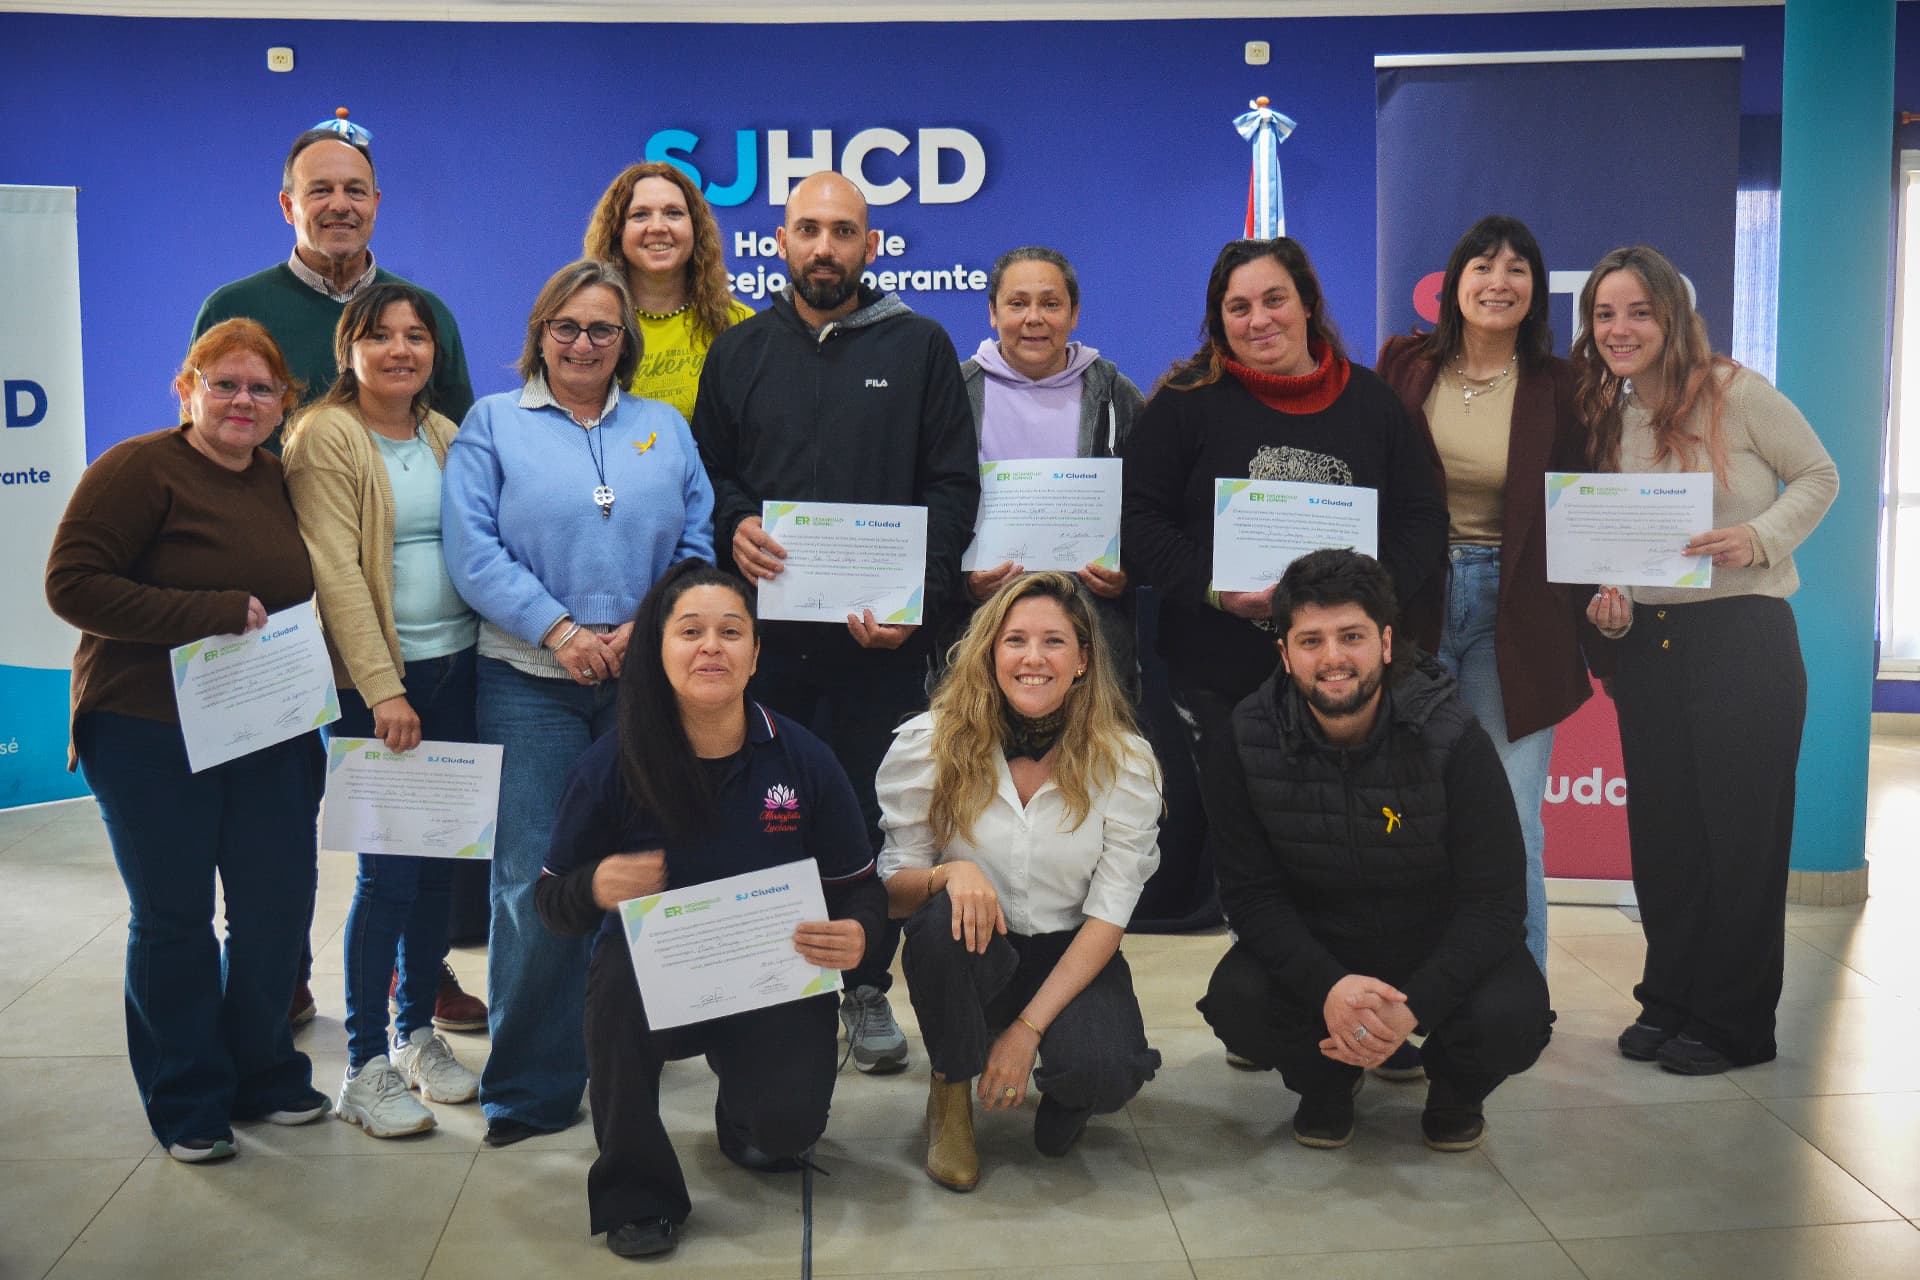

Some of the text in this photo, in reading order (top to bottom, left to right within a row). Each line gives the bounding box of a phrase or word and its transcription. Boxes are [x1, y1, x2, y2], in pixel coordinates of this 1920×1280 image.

[637, 351, 703, 377] akery
[865, 378, 888, 388] FILA
[1065, 472, 1098, 480] Ciudad
[1653, 488, 1687, 496] Ciudad
[1321, 499, 1353, 507] Ciudad
[868, 520, 901, 528] Ciudad
[272, 624, 299, 639] Ciudad
[441, 756, 475, 765] Ciudad
[751, 883, 790, 898] Ciudad
